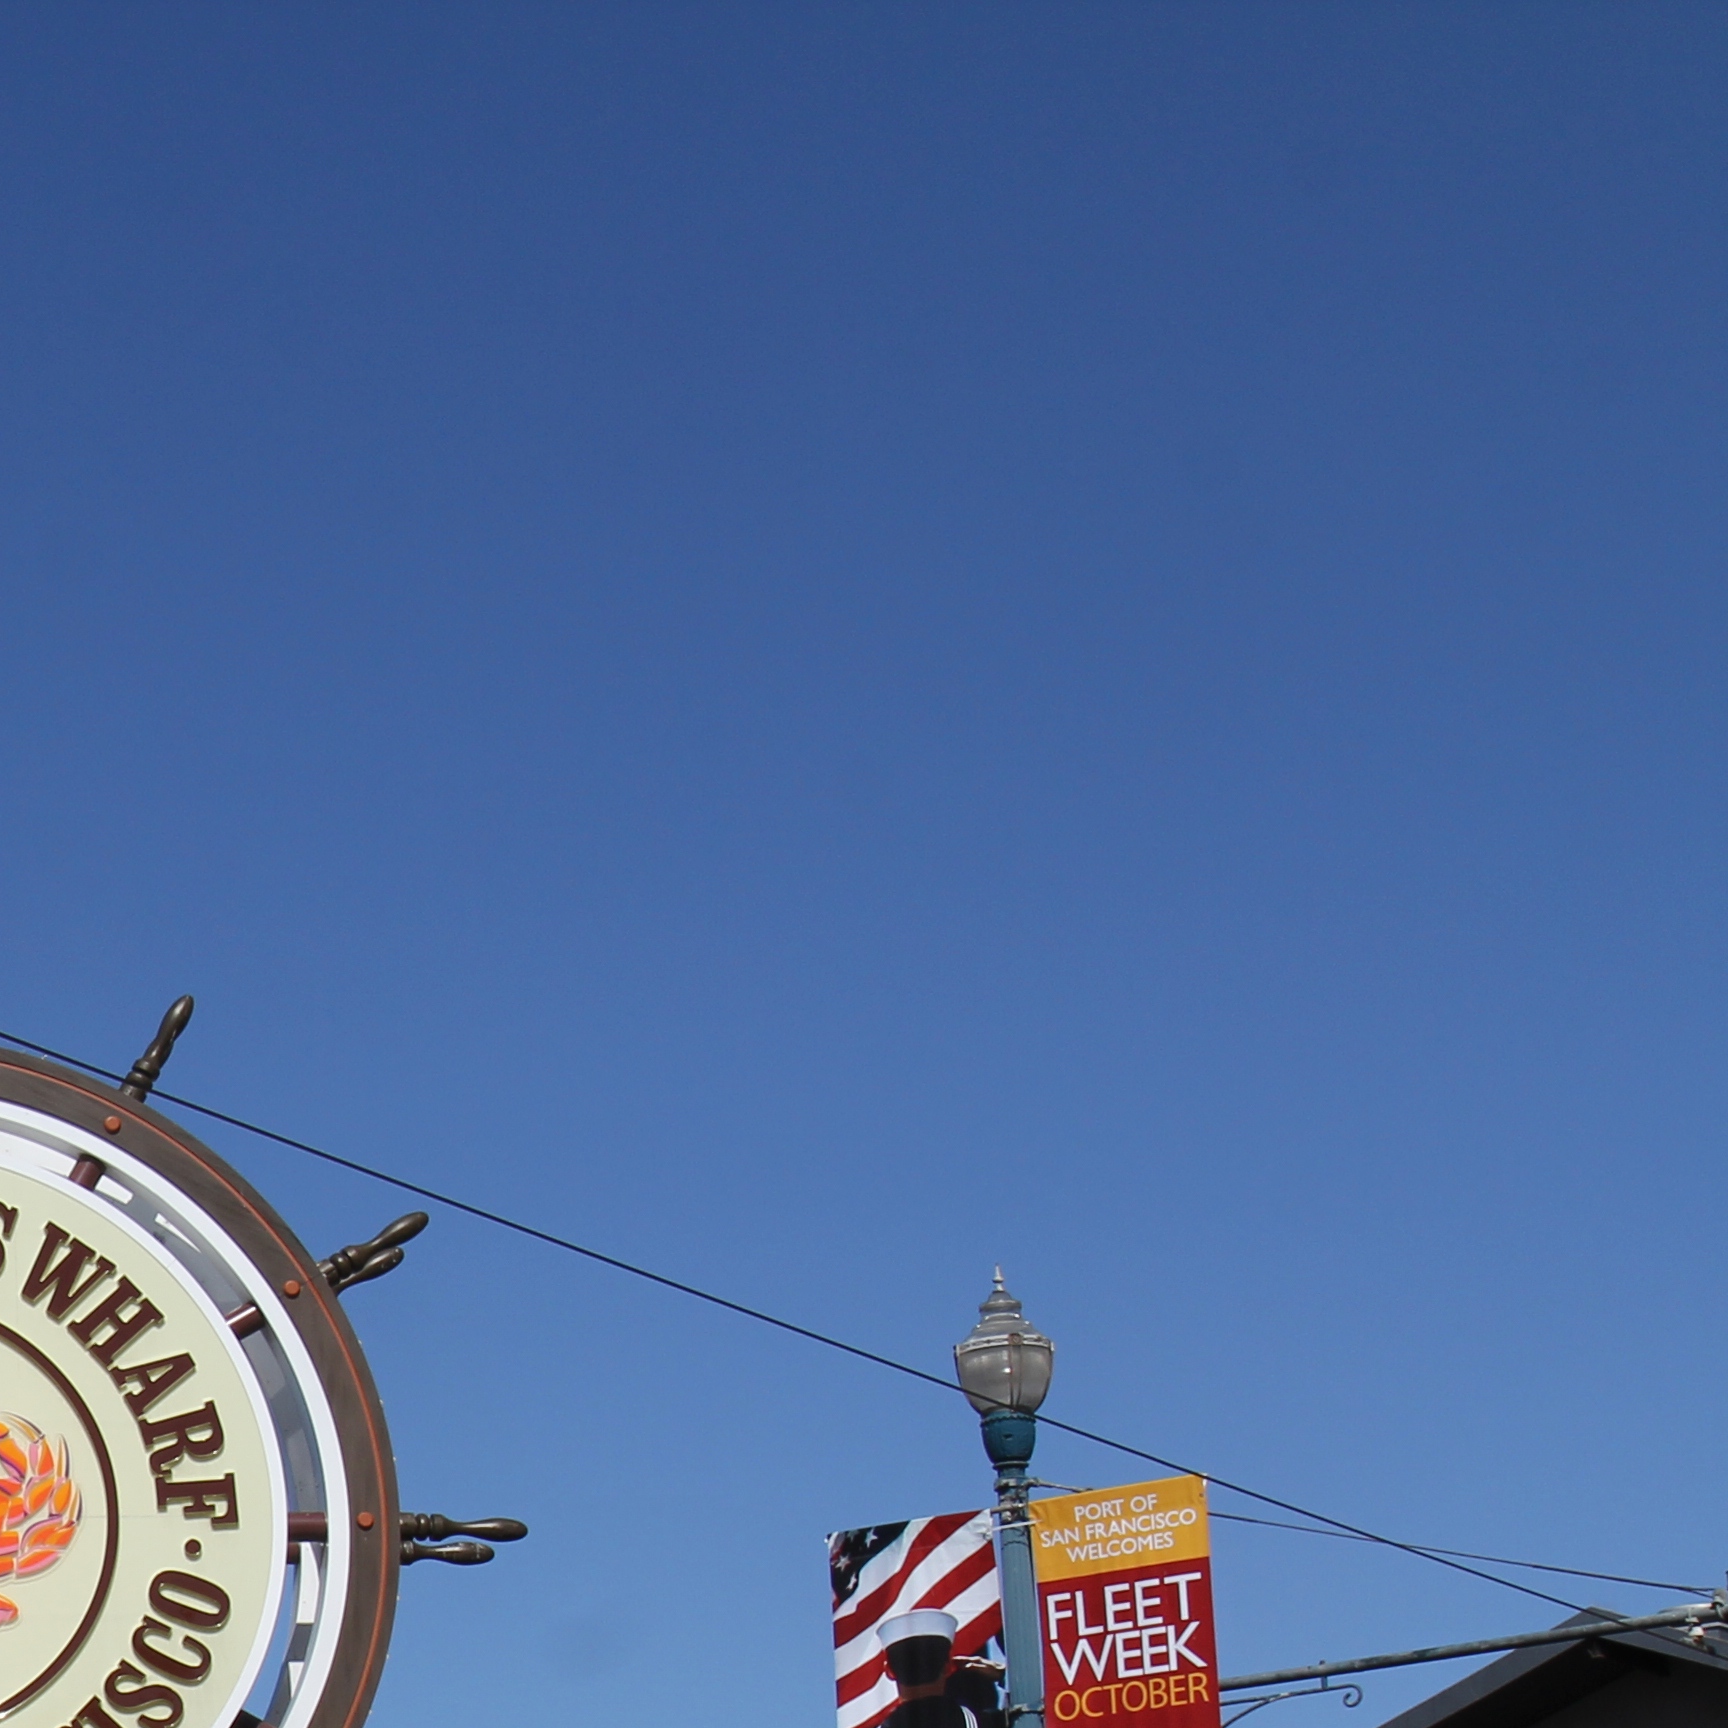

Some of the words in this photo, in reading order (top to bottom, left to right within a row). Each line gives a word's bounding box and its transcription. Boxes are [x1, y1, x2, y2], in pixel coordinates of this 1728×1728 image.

[23, 1220, 238, 1530] WHARF
[1040, 1528, 1080, 1548] SAN
[1086, 1508, 1197, 1541] FRANCISCO
[1074, 1499, 1124, 1522] PORT
[1130, 1494, 1157, 1513] OF
[1066, 1531, 1174, 1562] WELCOMES
[1046, 1571, 1202, 1640] FLEET
[1049, 1621, 1208, 1686] WEEK
[1054, 1672, 1209, 1721] OCTOBER
